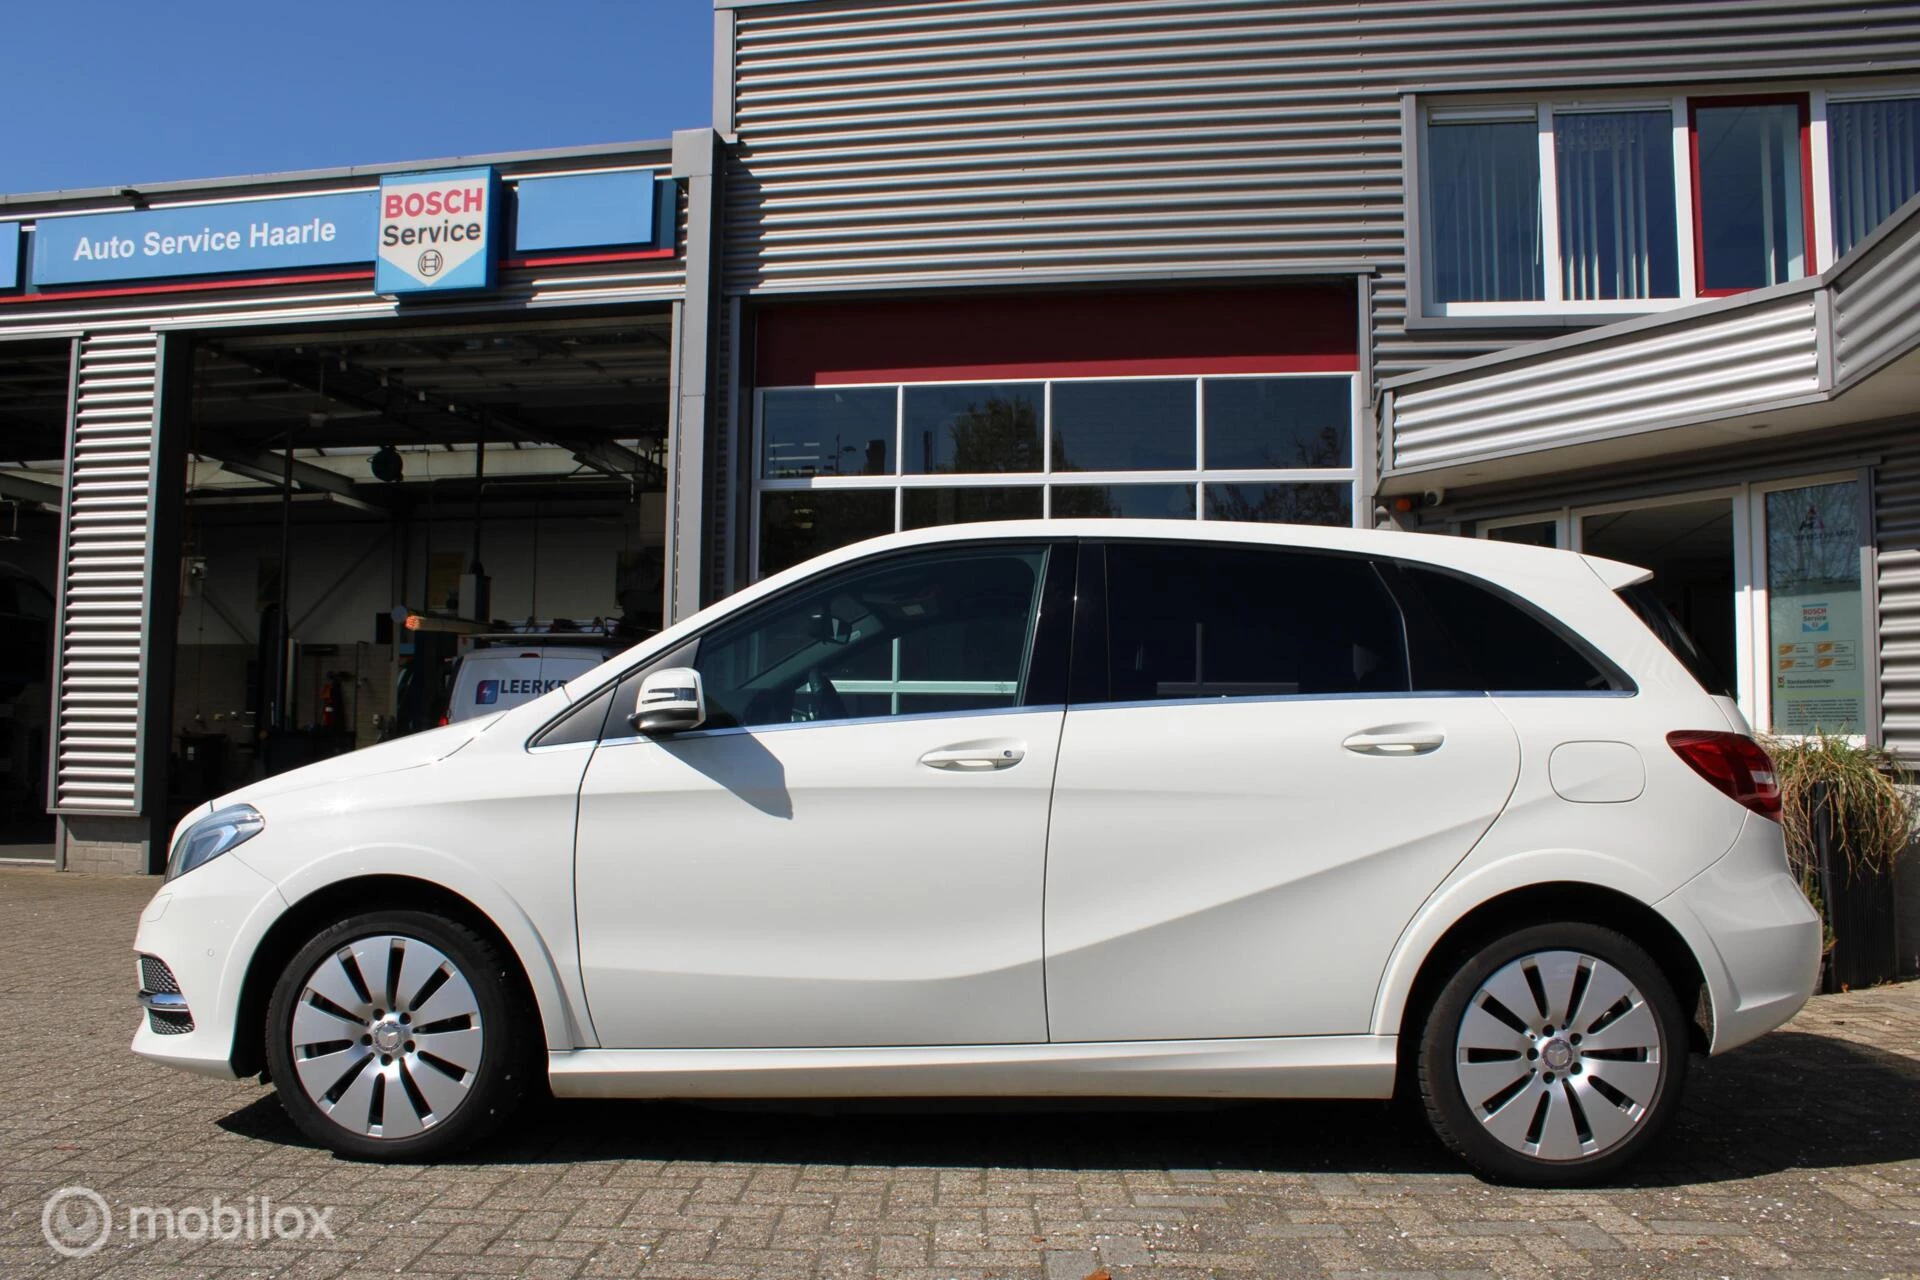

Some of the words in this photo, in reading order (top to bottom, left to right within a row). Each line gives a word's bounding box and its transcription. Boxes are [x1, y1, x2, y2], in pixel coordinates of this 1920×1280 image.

[385, 187, 483, 219] BOSCH
[73, 236, 135, 261] Auto
[143, 227, 241, 256] Service
[249, 218, 336, 248] Haarle
[383, 219, 481, 247] Service
[1802, 607, 1827, 616] BOSCH
